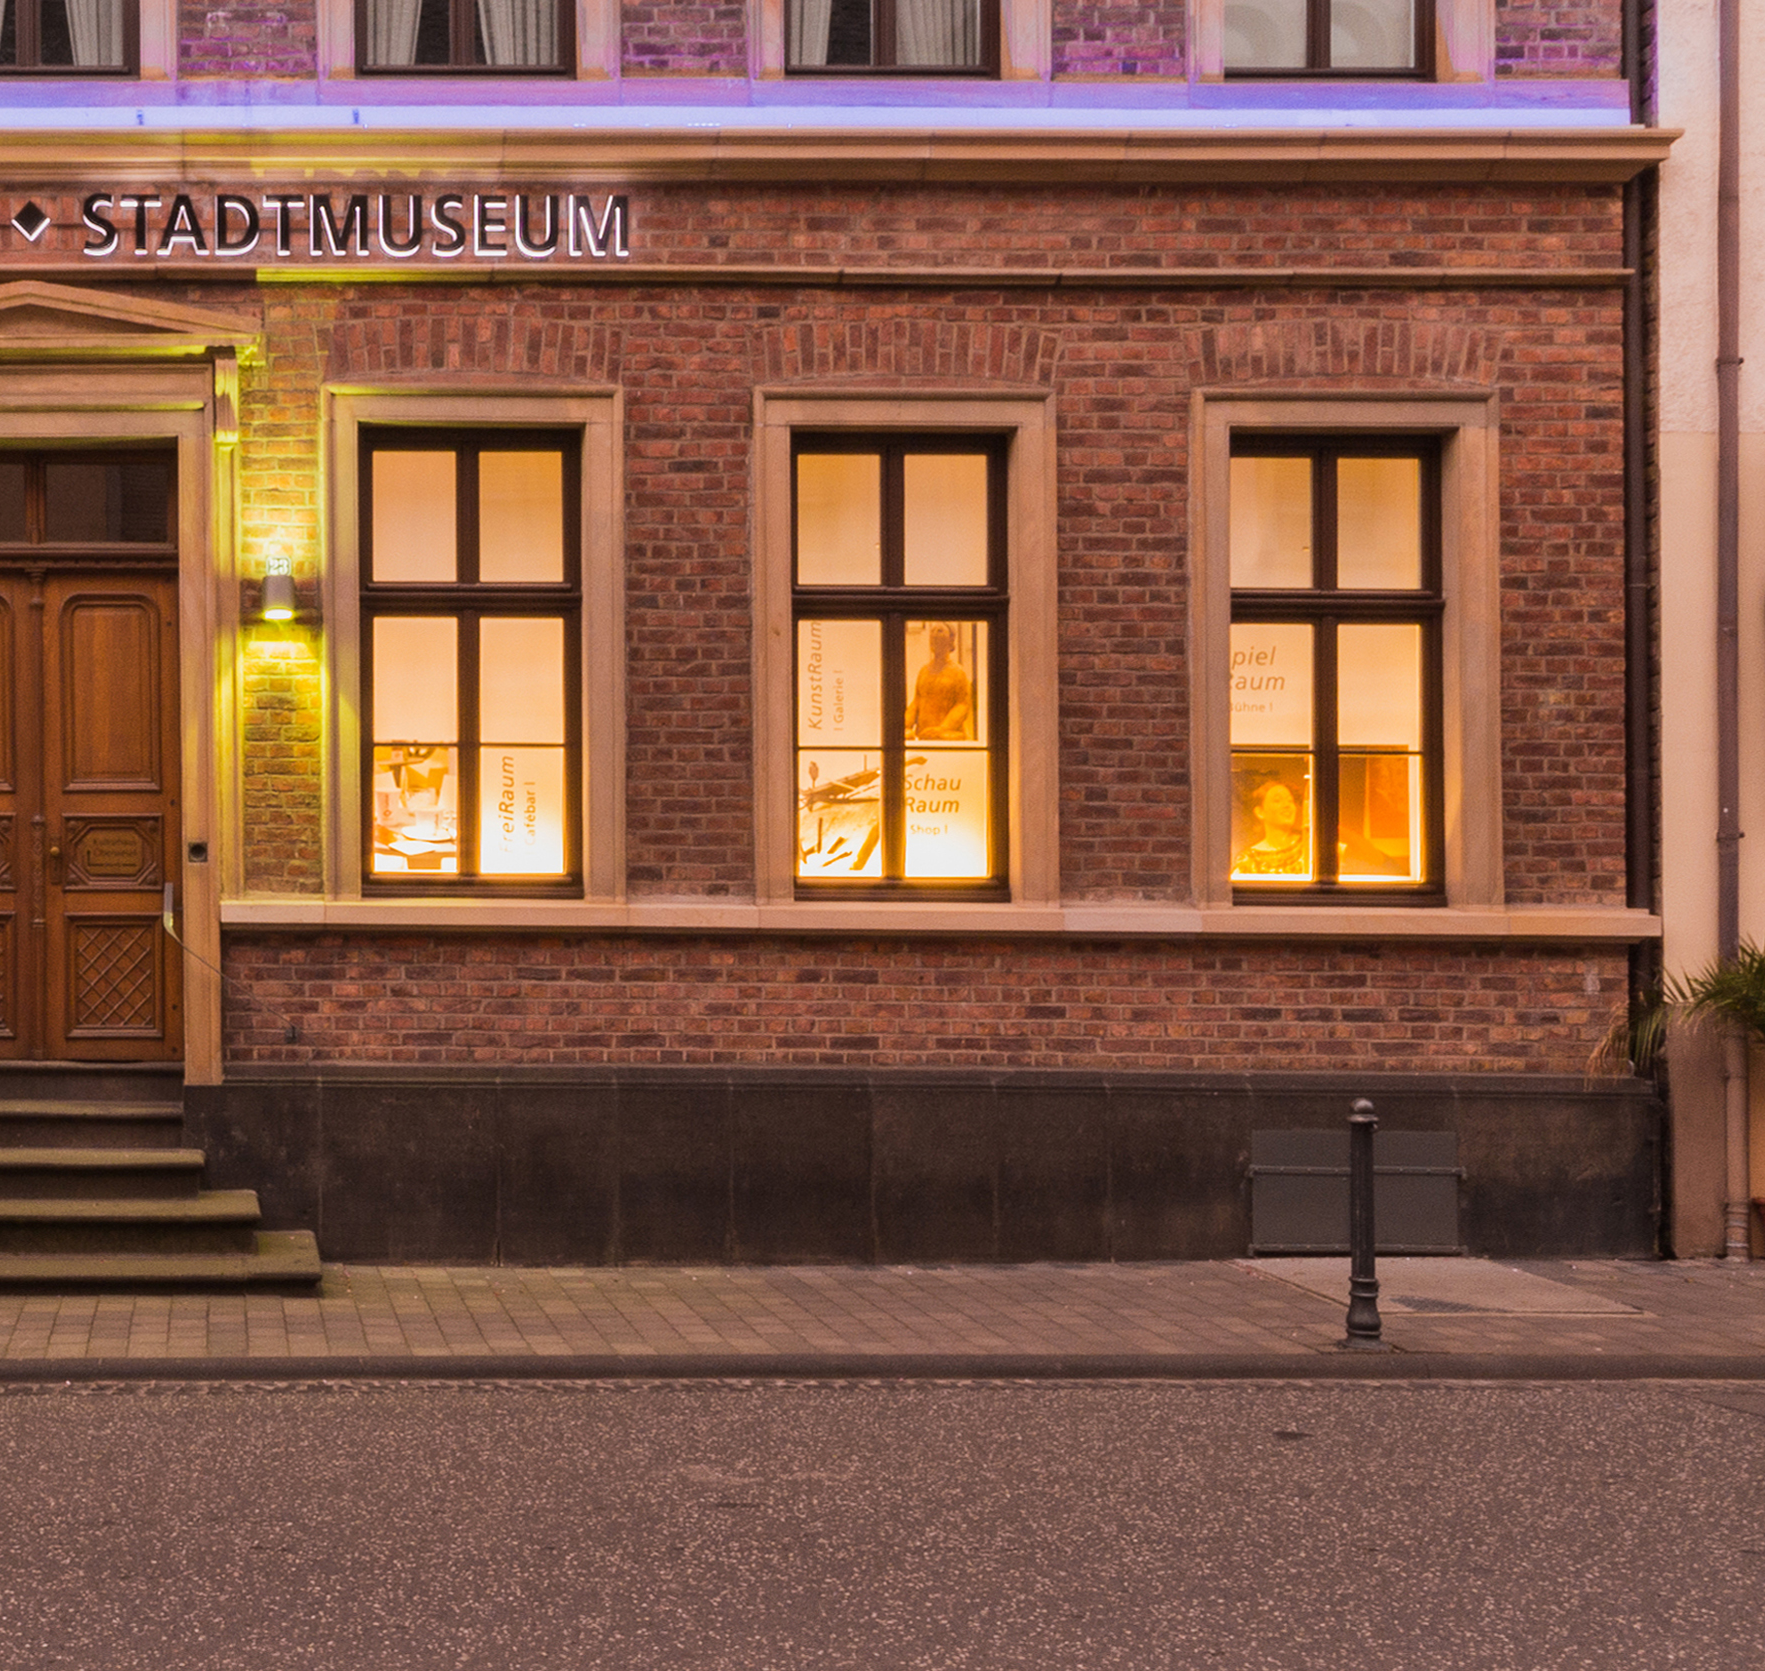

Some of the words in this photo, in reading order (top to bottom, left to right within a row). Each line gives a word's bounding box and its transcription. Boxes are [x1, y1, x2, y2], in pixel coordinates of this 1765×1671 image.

[82, 192, 630, 258] STADTMUSEUM
[1231, 645, 1276, 670] piel
[808, 620, 822, 730] KunstRaum
[1230, 675, 1285, 690] aum
[833, 677, 845, 724] Galerie
[905, 773, 962, 791] Schau
[905, 796, 960, 814] Raum
[910, 824, 941, 835] Shop
